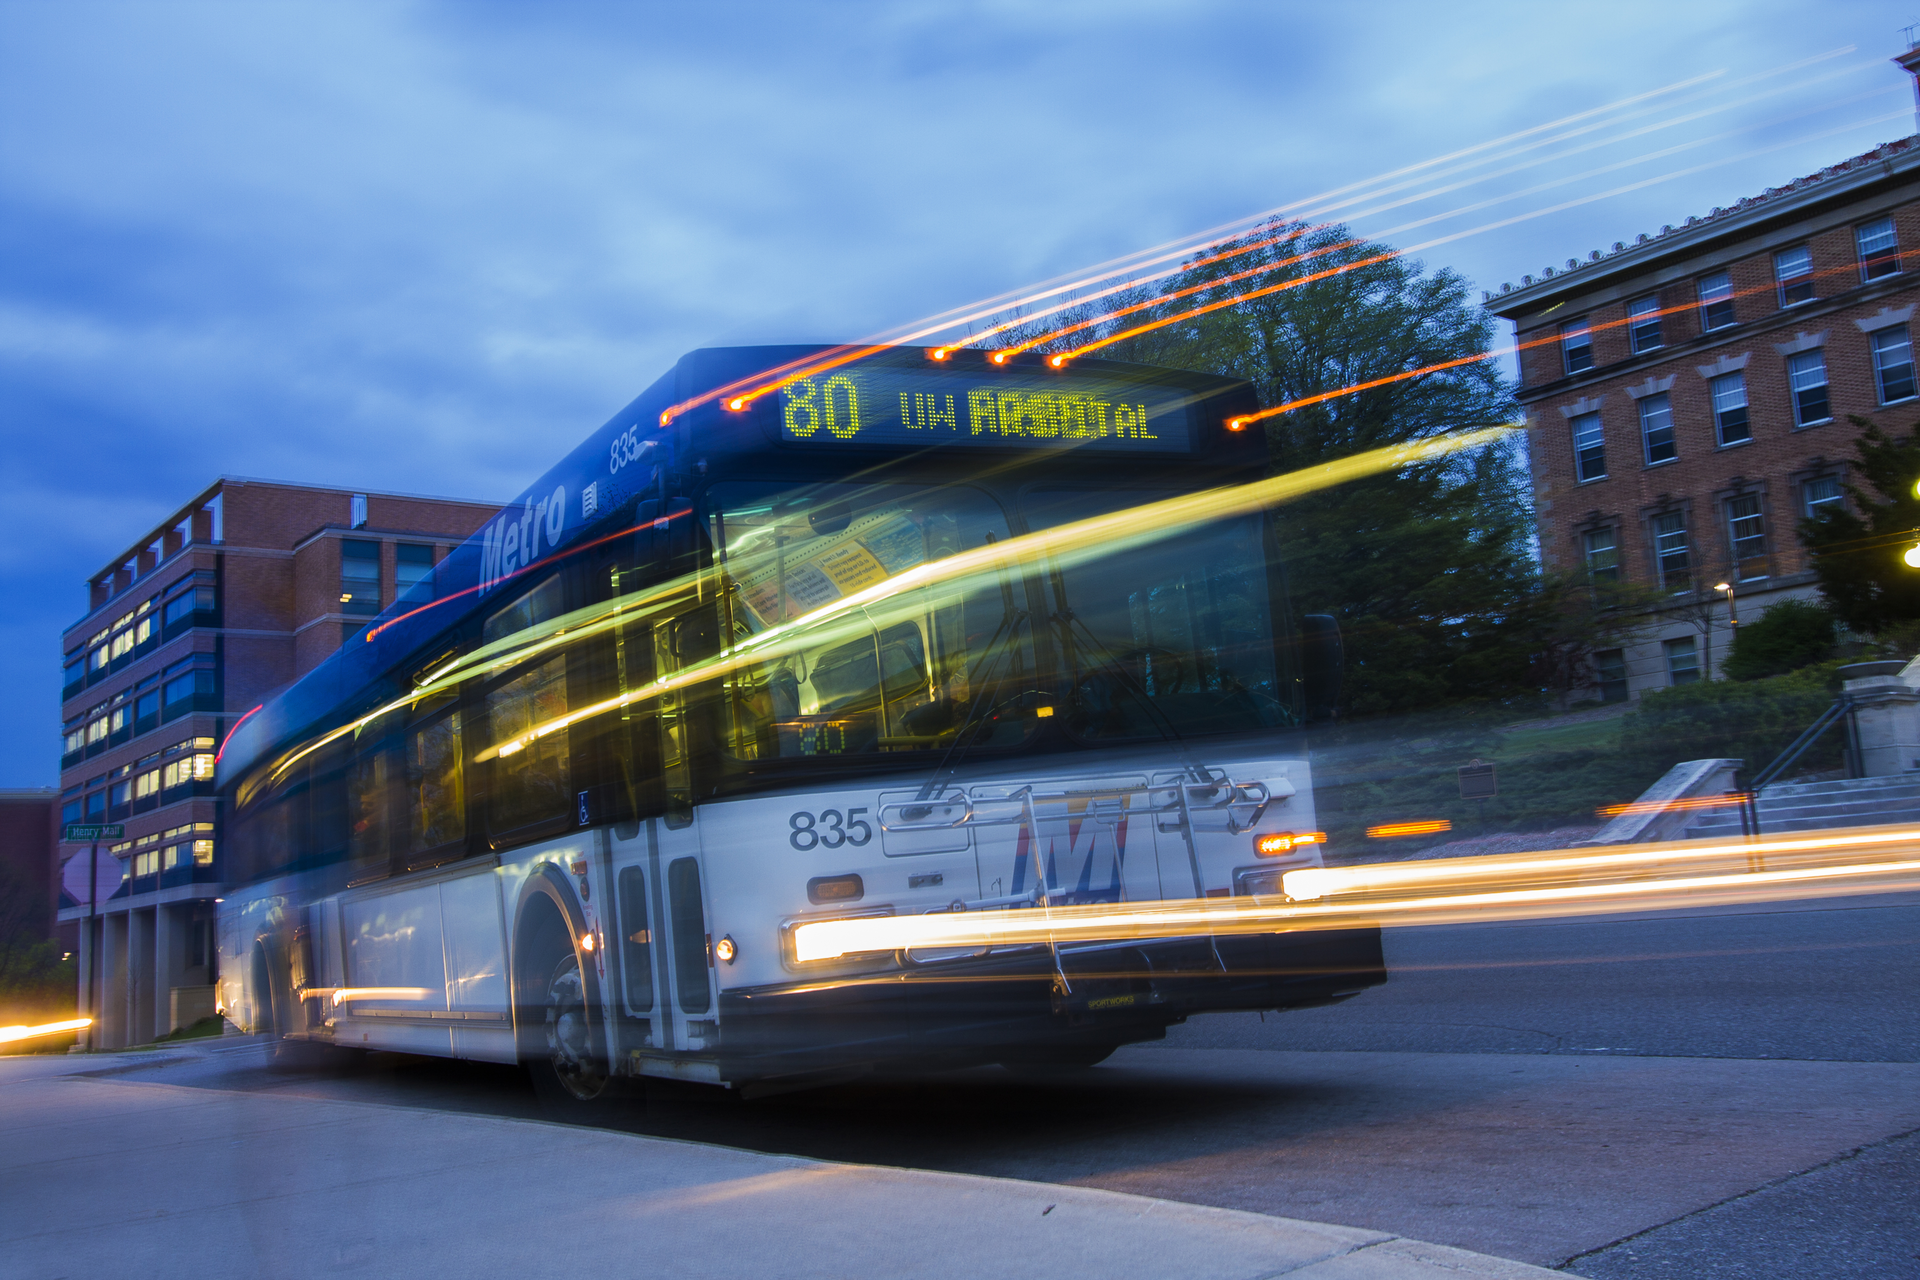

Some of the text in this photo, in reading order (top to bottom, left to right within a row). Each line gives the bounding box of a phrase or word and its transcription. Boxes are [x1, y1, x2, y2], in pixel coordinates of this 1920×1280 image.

[783, 374, 860, 438] 80
[900, 392, 956, 431] UW
[610, 424, 638, 475] 835
[478, 485, 566, 598] Metro
[799, 722, 845, 755] 80
[73, 826, 120, 838] Henry Mall
[789, 807, 872, 851] 835
[1088, 996, 1134, 1008] SPORTWORKS
